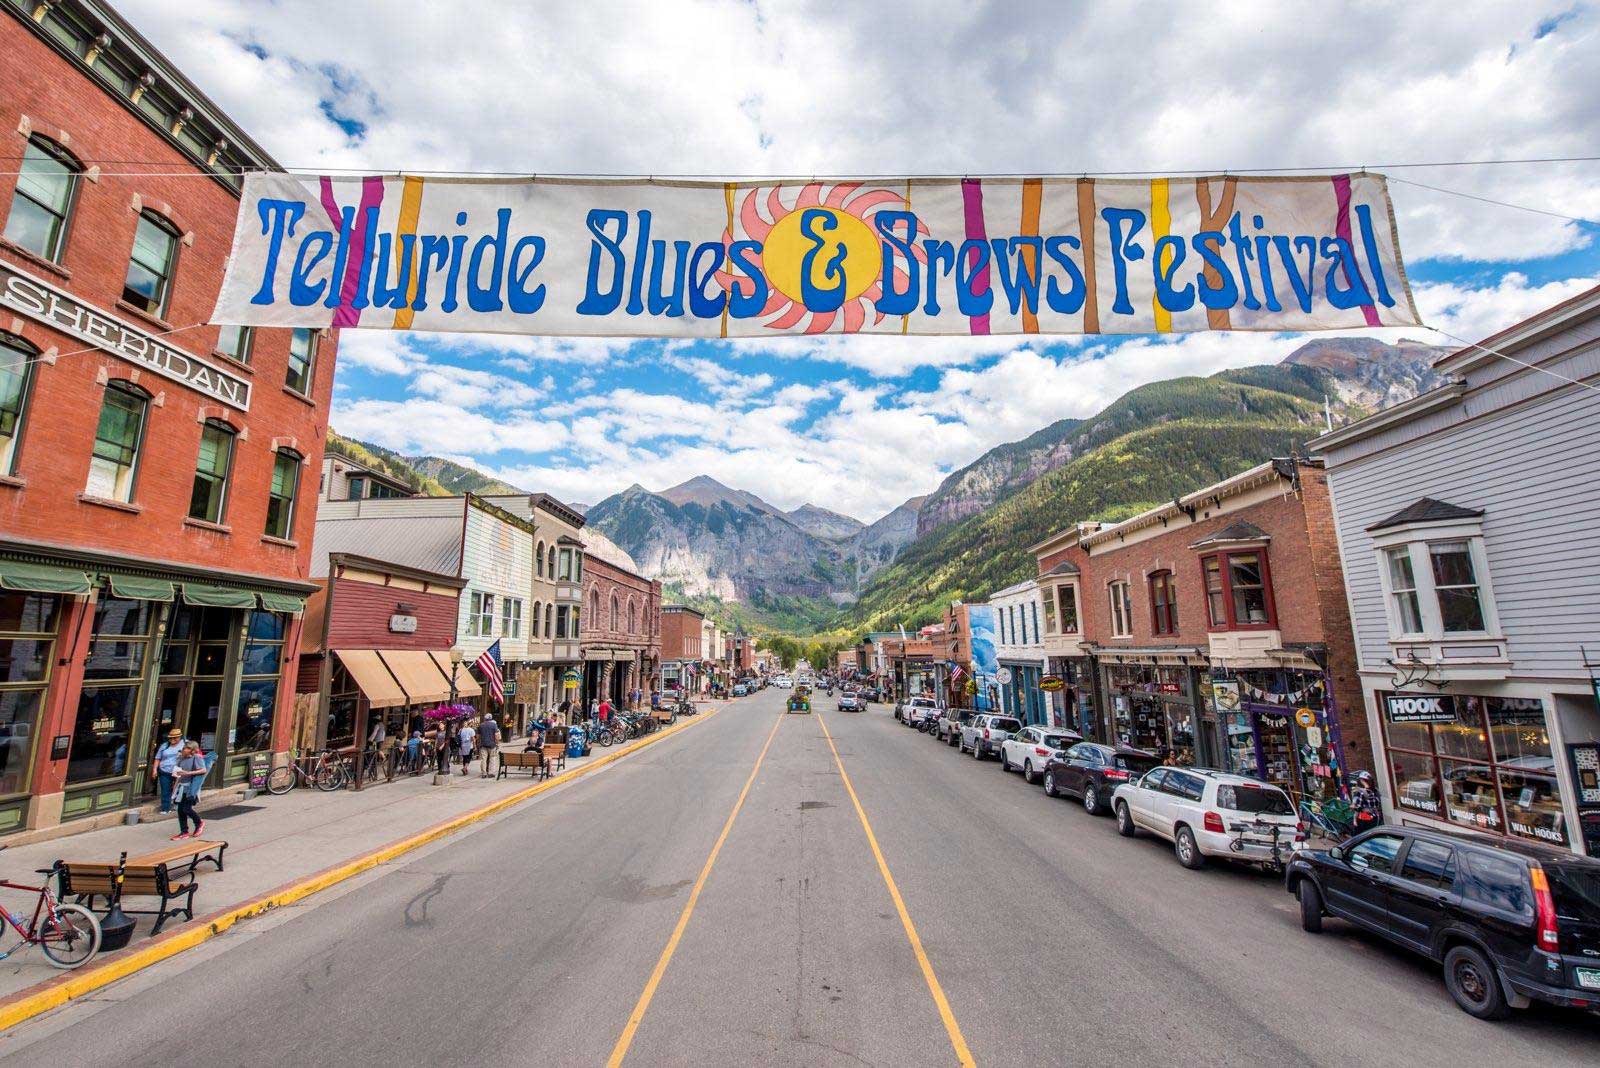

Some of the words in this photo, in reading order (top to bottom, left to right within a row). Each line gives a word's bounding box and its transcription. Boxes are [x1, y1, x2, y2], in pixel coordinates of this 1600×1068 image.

[249, 198, 548, 316] Telluride
[575, 207, 770, 319] Blues
[800, 208, 847, 314] &
[873, 209, 1088, 317] Brews
[1101, 203, 1396, 317] Festival
[1391, 698, 1443, 714] HOOK
[1511, 822, 1533, 835] WALL
[1534, 826, 1563, 842] HOOKS
